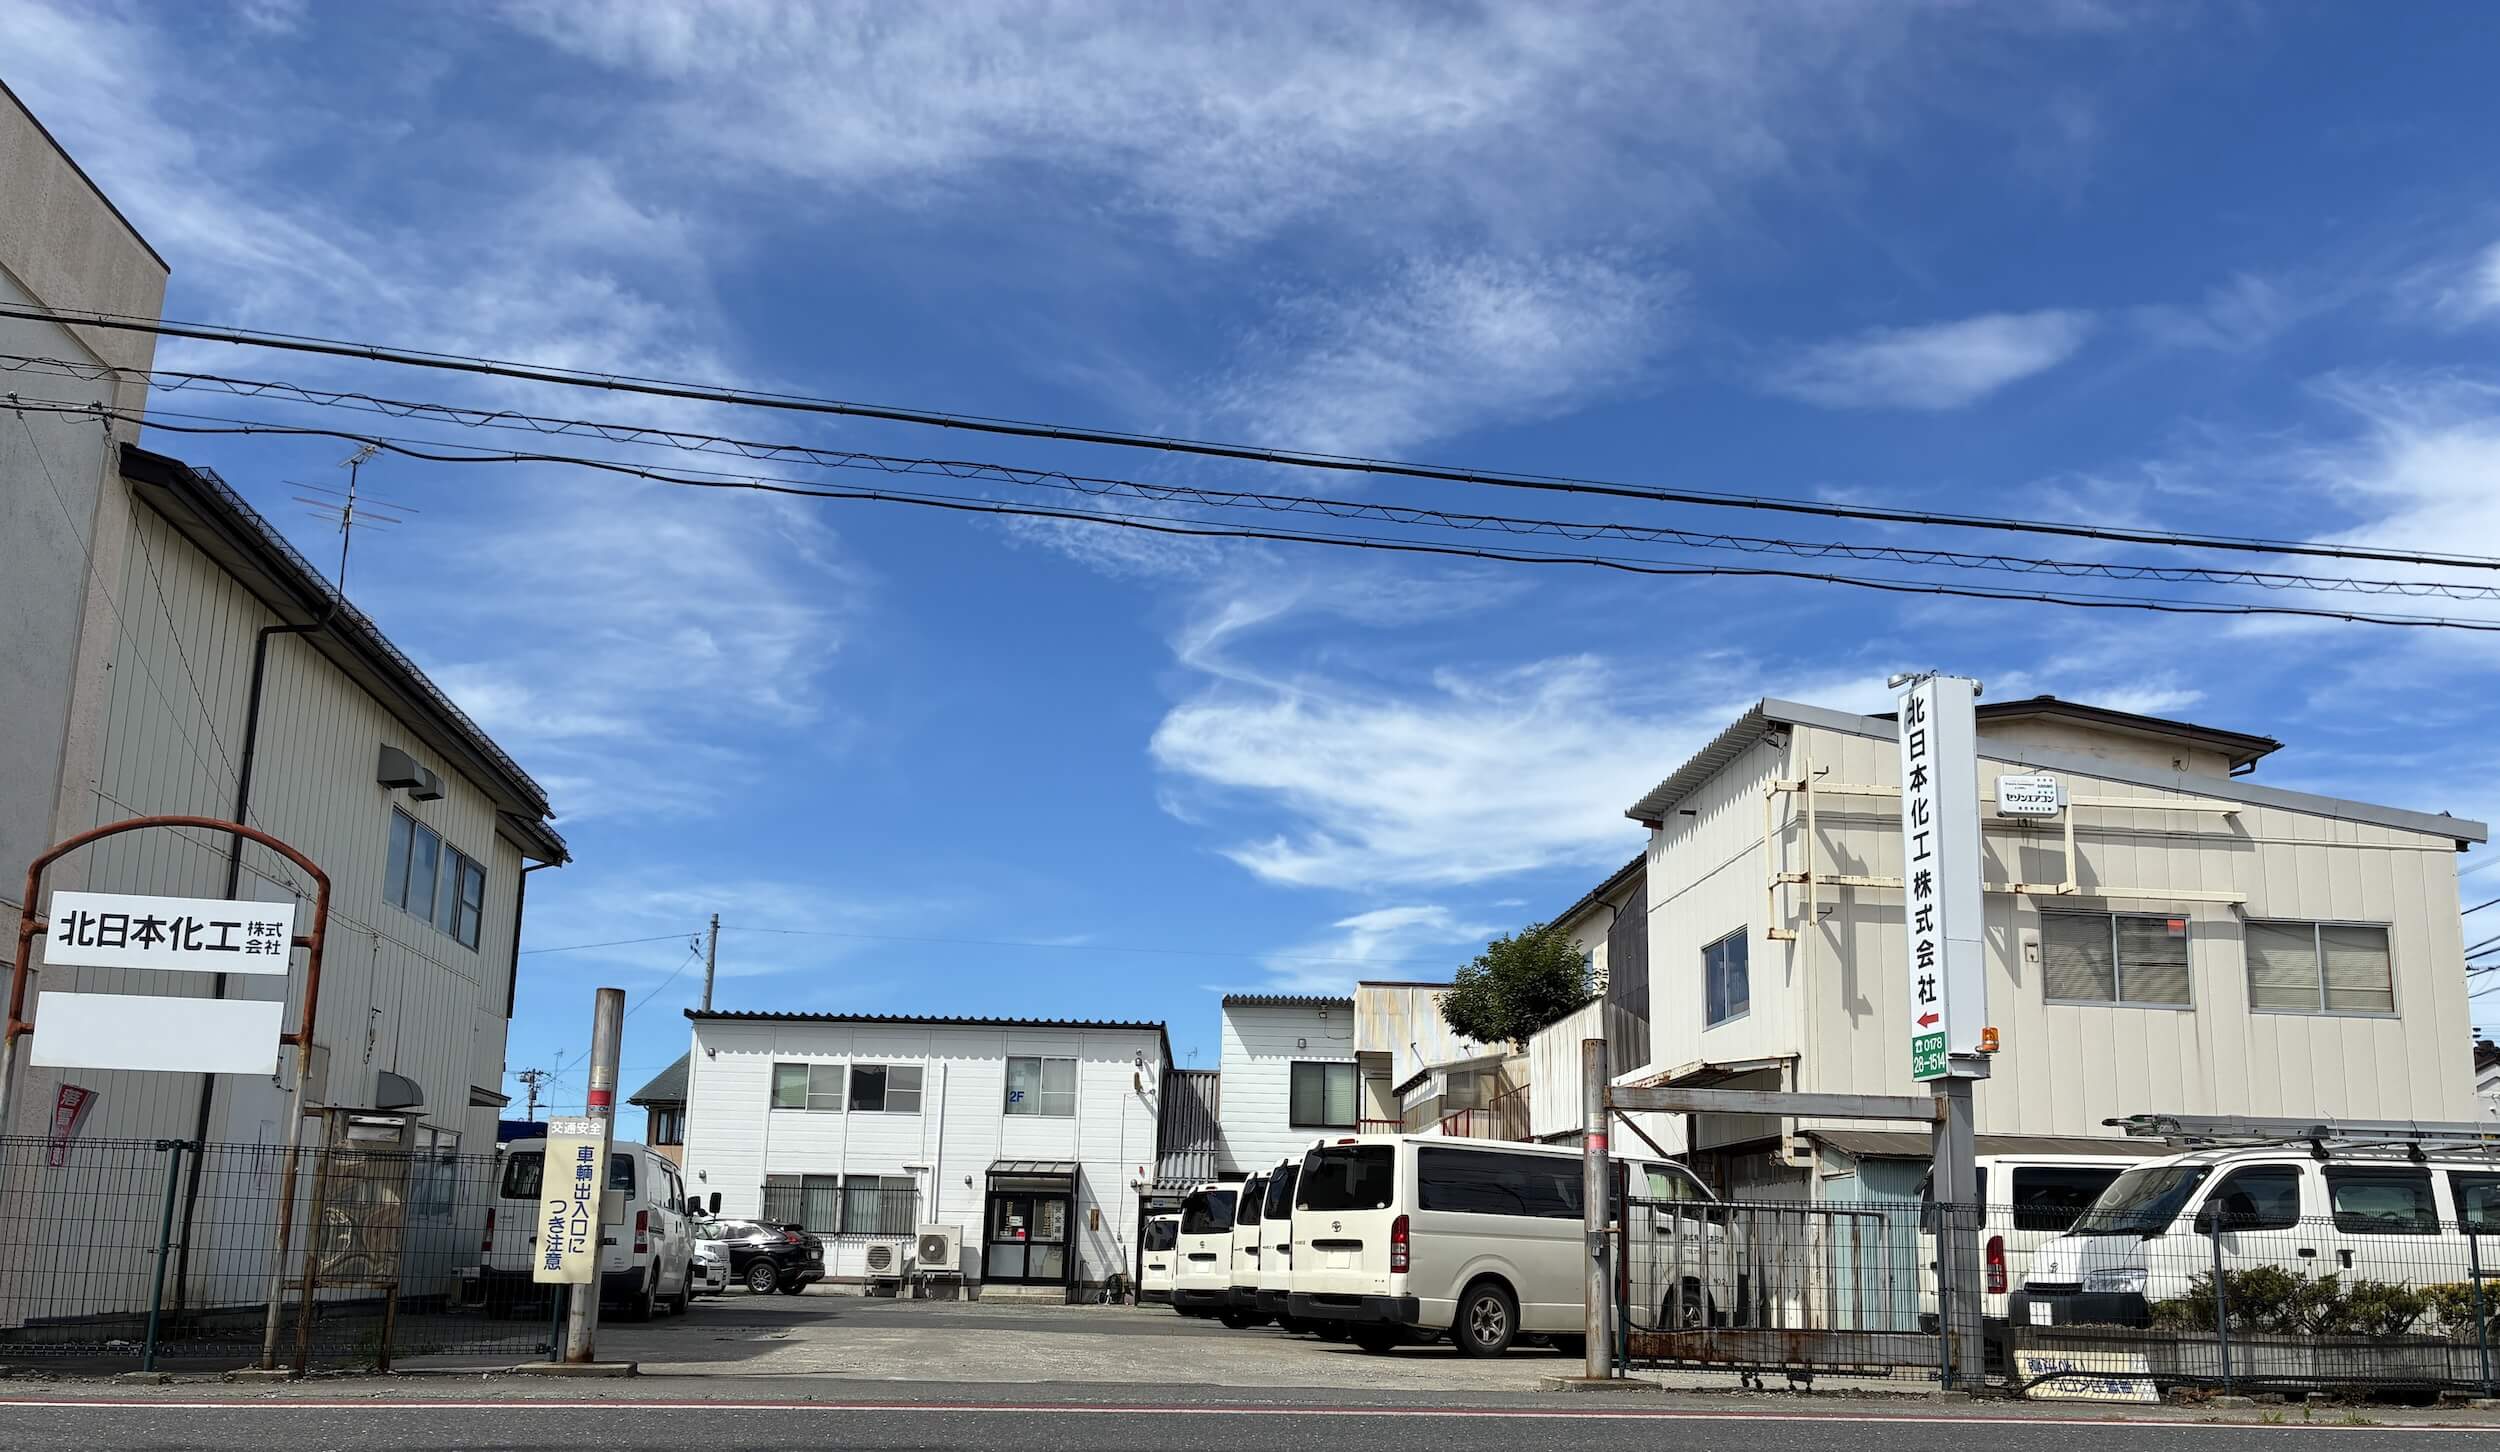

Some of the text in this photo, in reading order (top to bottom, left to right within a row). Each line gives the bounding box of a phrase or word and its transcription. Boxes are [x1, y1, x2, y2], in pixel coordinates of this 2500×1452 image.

[1907, 696, 1937, 1005] 北日本化工株式会社
[58, 910, 242, 952] 北日本化工
[1924, 1037, 1943, 1052] 0178
[1914, 1051, 1946, 1073] 28-1514
[1009, 1091, 1024, 1102] 2F
[551, 1121, 602, 1135] 交通安全
[544, 1200, 567, 1270] つき注意
